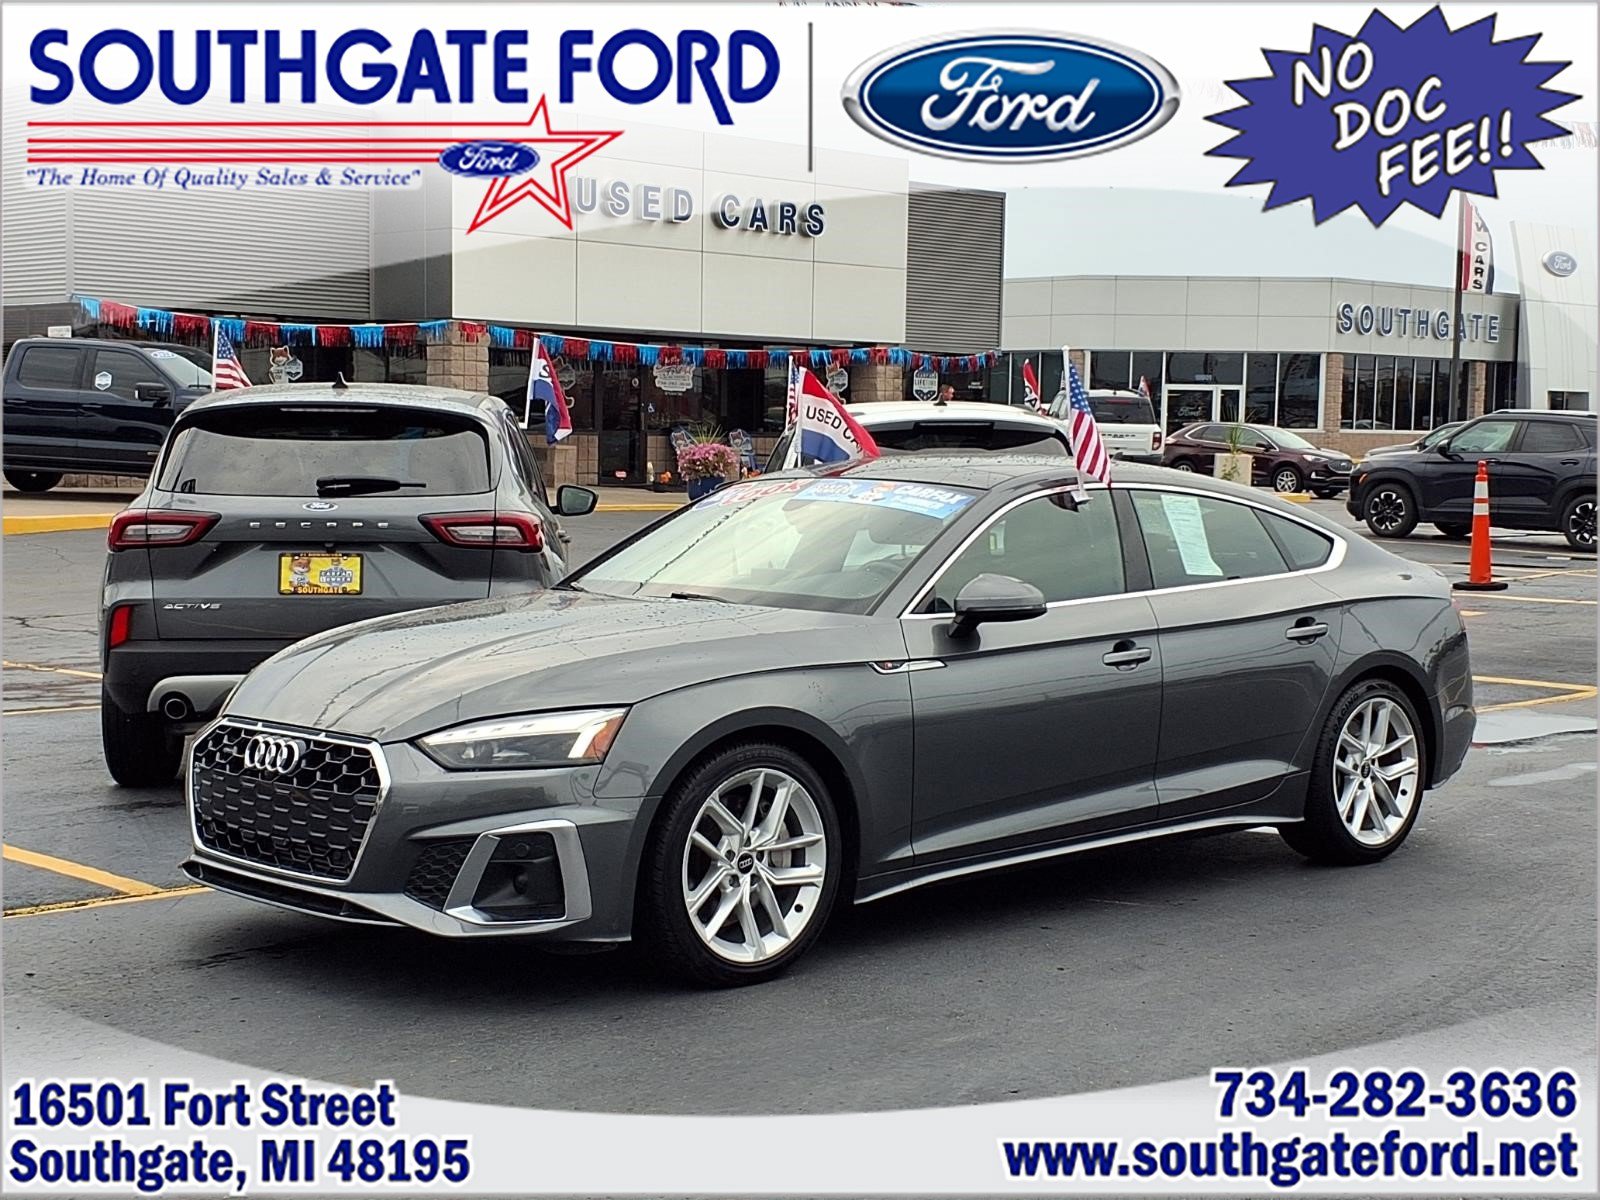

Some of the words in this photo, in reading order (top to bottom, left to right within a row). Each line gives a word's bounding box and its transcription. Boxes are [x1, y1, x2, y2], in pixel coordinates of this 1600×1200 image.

[575, 177, 694, 223] USED
[718, 194, 826, 237] CARS
[1472, 241, 1488, 290] CARS
[1339, 302, 1499, 342] SOUTHGATE
[806, 405, 842, 430] USED
